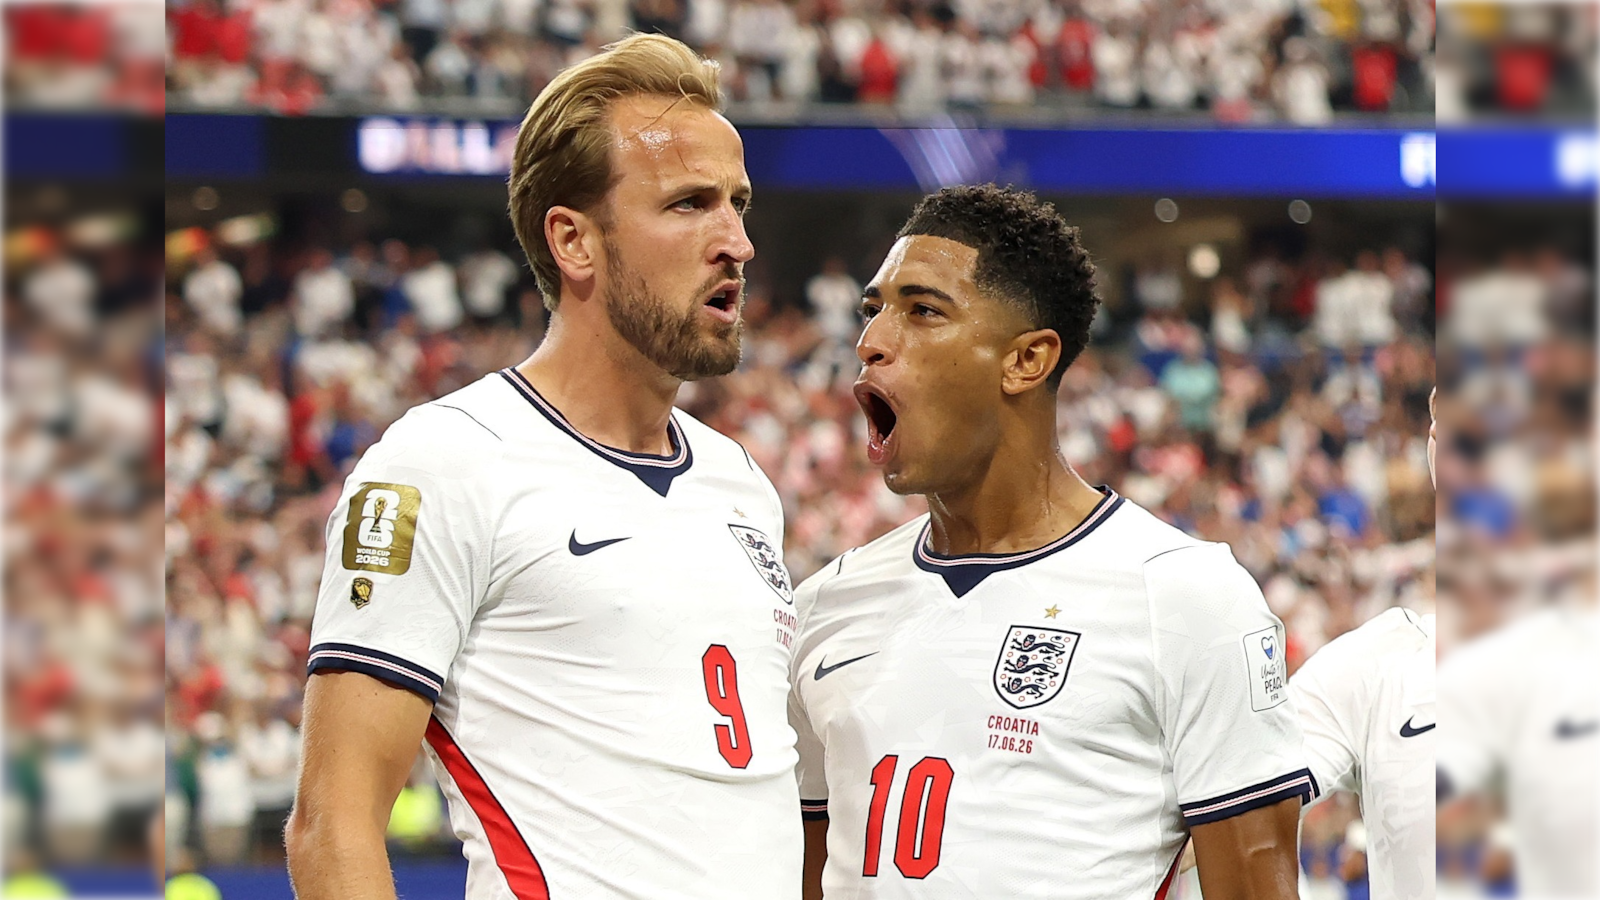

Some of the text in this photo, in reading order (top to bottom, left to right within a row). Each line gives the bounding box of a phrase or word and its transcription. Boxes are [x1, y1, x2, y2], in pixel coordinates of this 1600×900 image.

[367, 534, 382, 542] FIFA
[356, 555, 390, 567] 2026
[357, 548, 391, 557] WORLD CUP
[702, 643, 753, 769] 9
[987, 714, 1040, 737] CROATIA
[987, 734, 1034, 755] 17.06.26
[862, 754, 955, 880] 10
